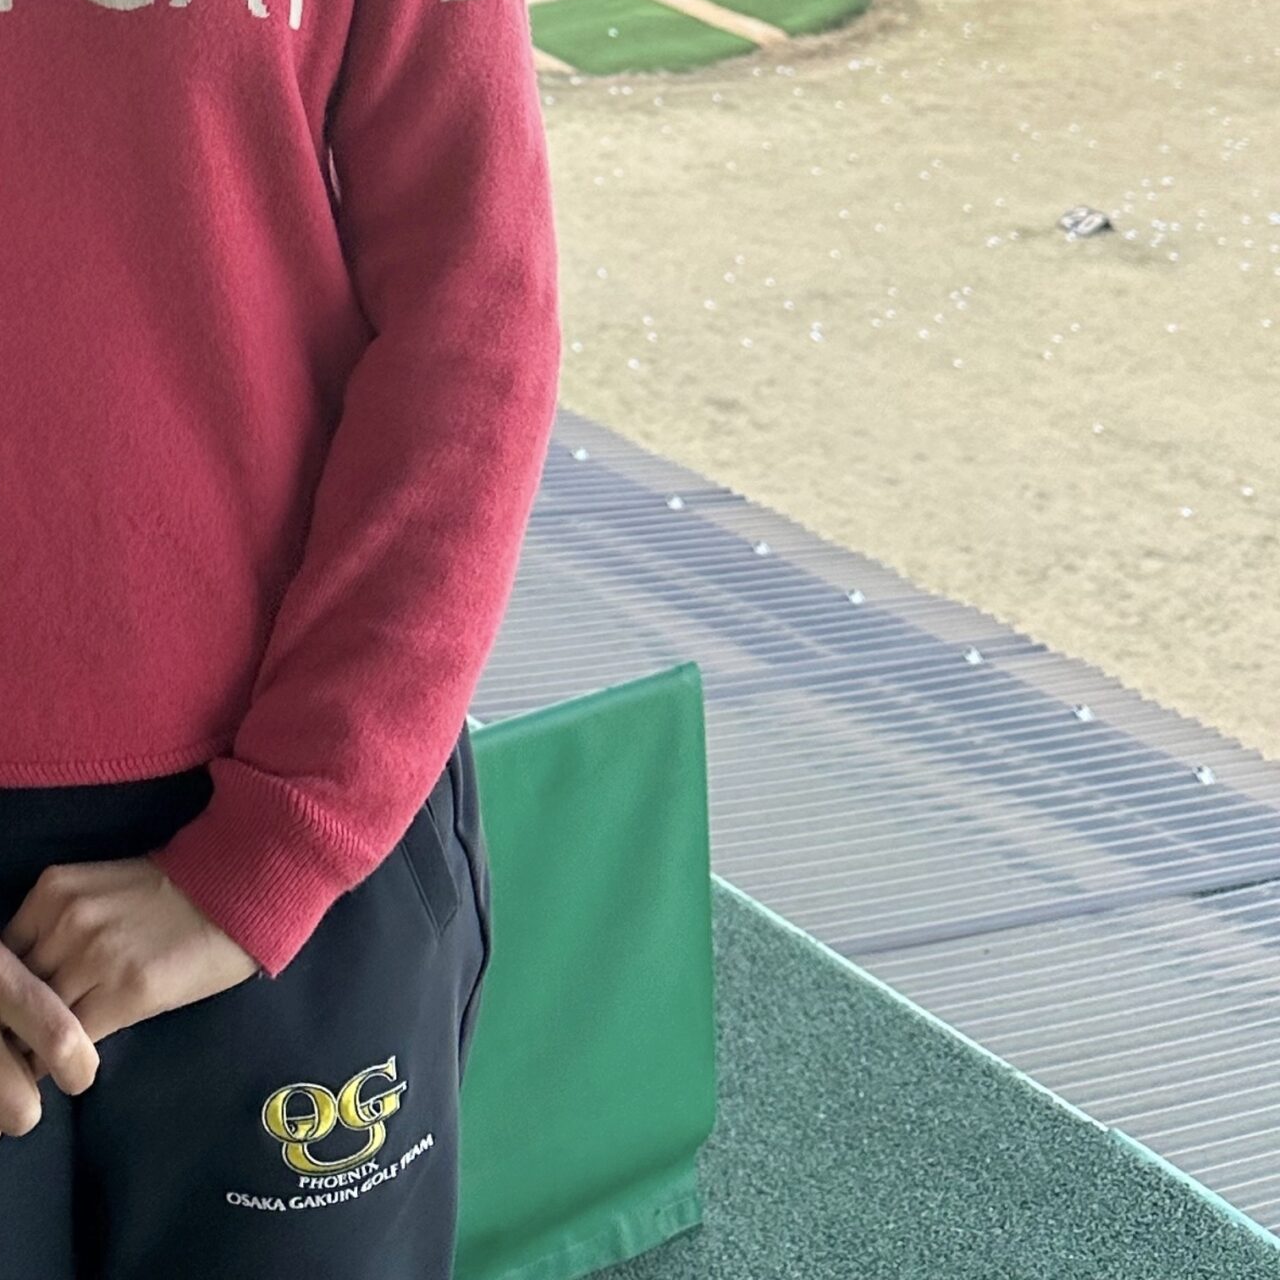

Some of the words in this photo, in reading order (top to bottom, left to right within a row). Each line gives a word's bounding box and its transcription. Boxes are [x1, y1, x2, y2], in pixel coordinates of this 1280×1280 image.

[225, 1191, 287, 1212] OSAKA
[288, 1186, 360, 1210] GAKUIN
[360, 1162, 398, 1193] GOLF
[400, 1133, 434, 1170] TEAM
[298, 1157, 380, 1190] PHOENIX
